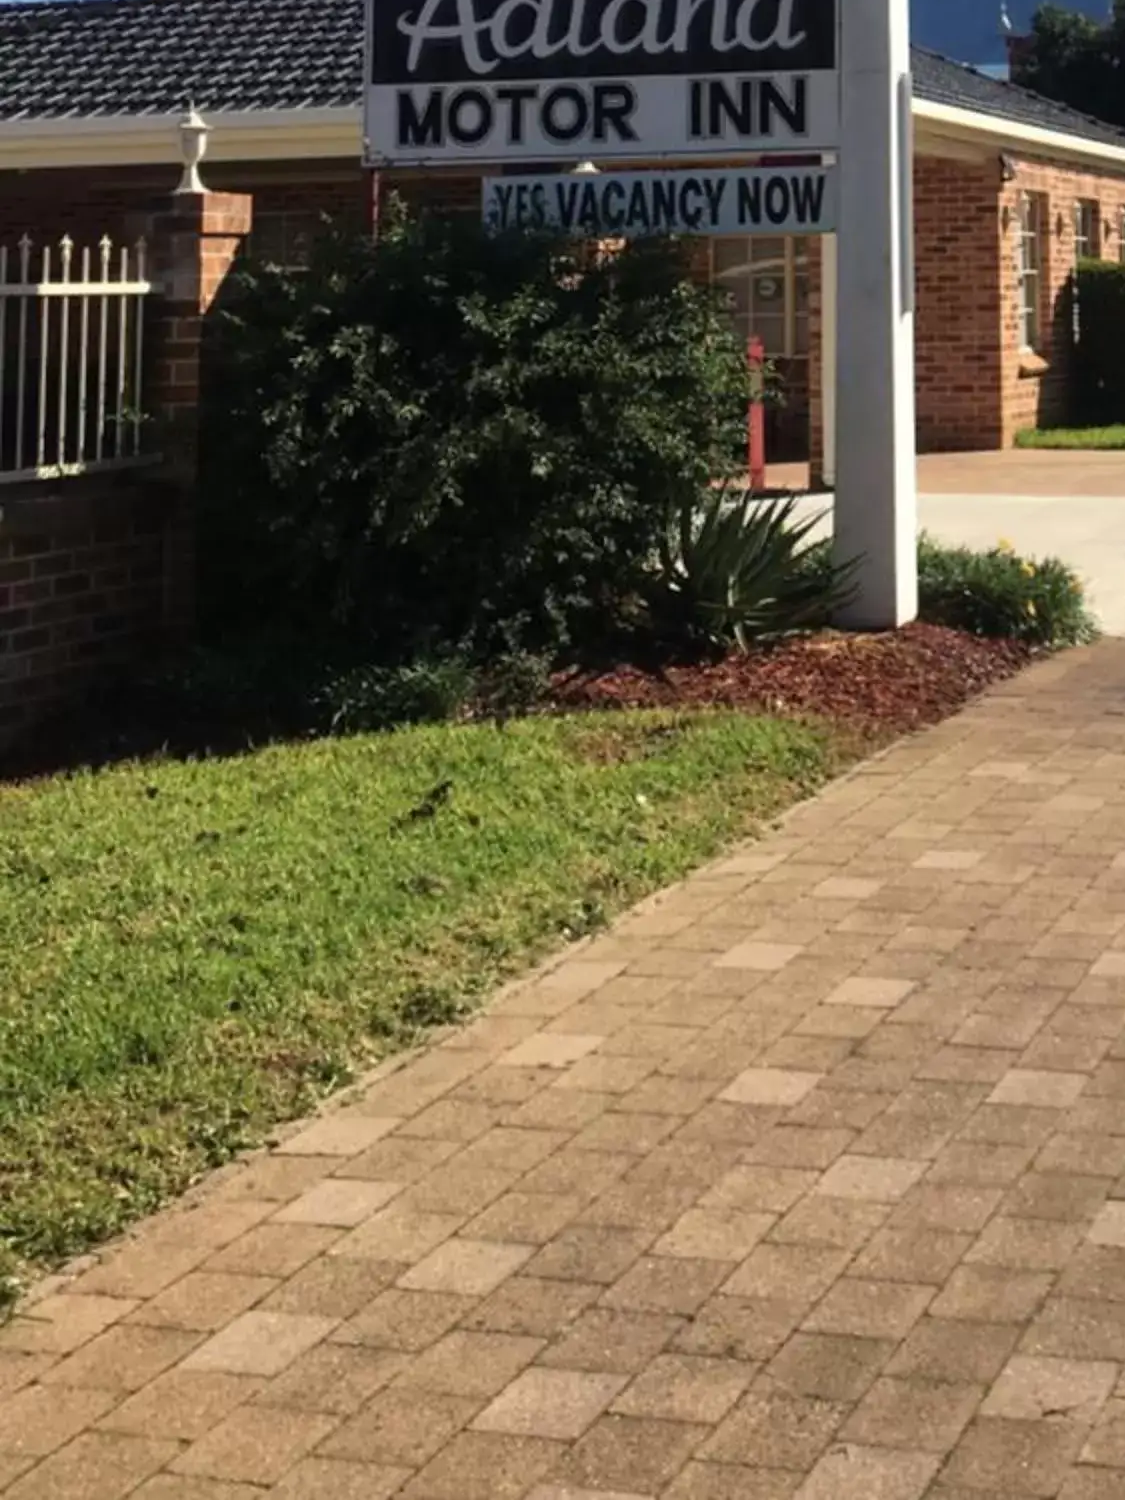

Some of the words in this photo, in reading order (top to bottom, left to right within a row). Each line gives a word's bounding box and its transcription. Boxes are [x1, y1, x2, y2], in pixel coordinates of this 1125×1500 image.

[396, 80, 640, 148] MOTOR
[688, 75, 808, 140] INN
[493, 181, 545, 230] YES
[556, 176, 727, 232] VACANCY
[737, 175, 825, 225] NOW
